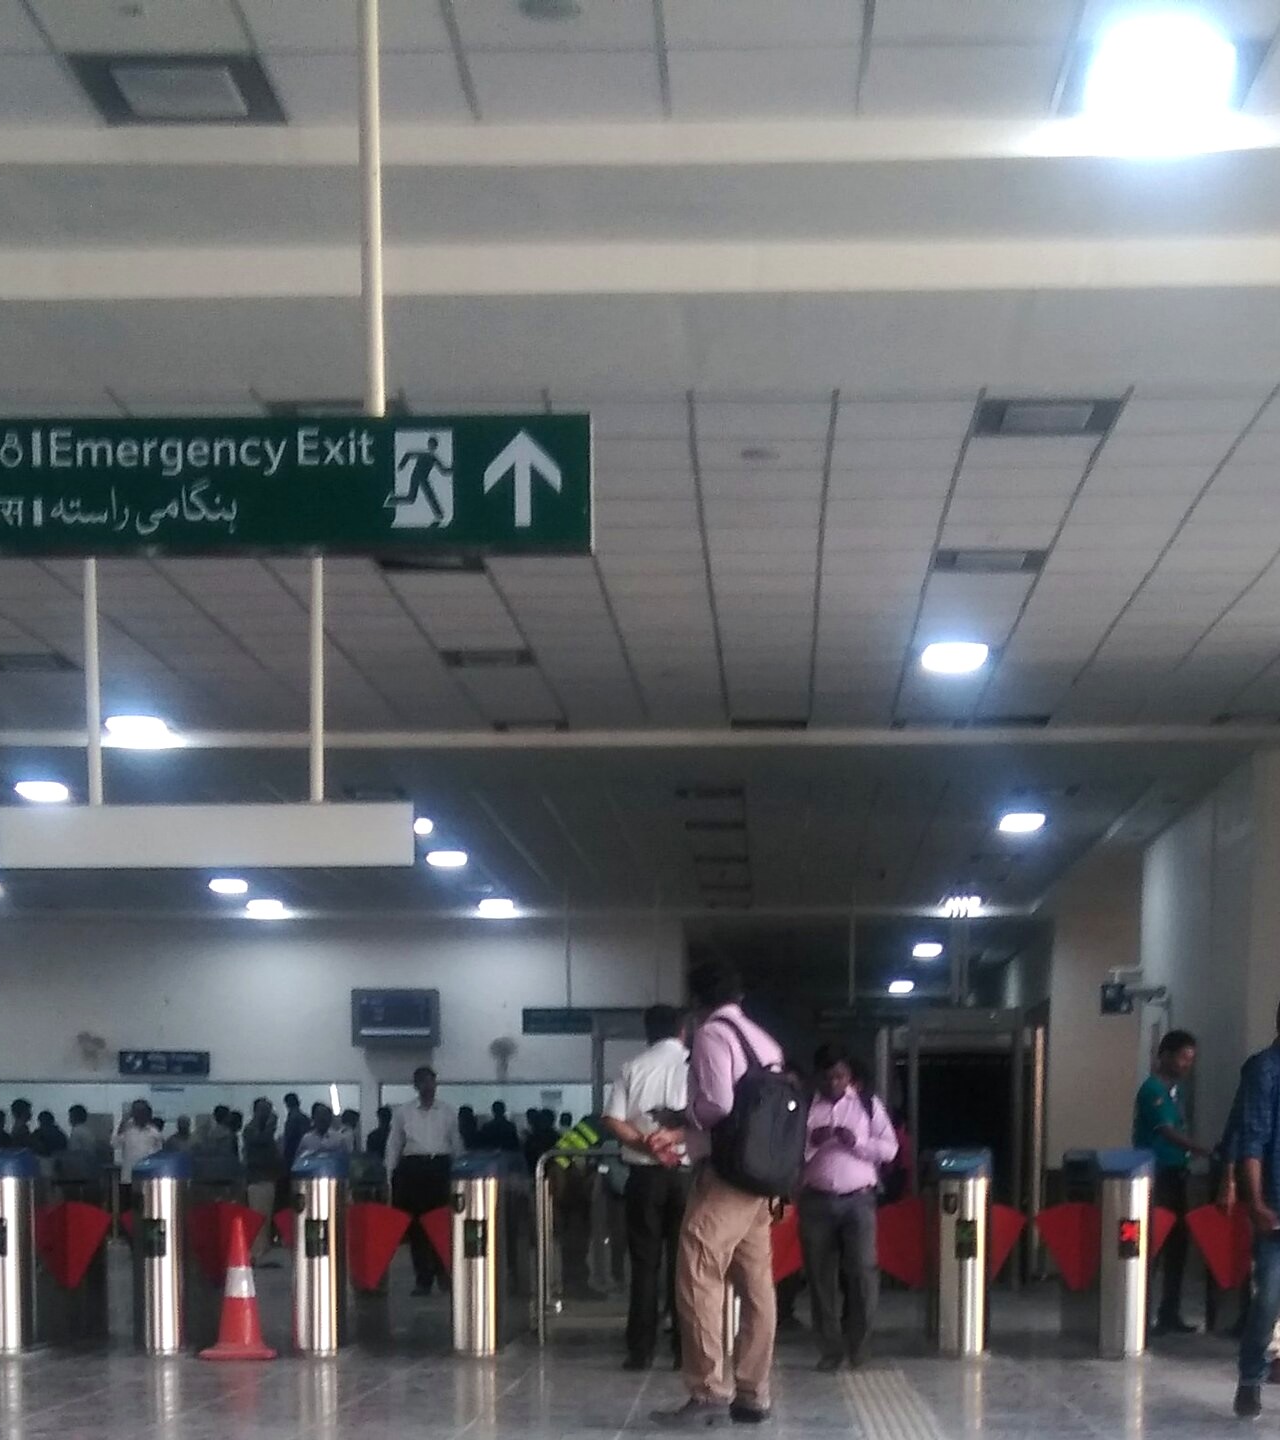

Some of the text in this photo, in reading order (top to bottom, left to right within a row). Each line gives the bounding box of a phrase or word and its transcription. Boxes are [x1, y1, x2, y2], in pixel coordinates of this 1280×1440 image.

[49, 426, 375, 477] Emergency Exit
[50, 476, 238, 535] ہنگامی راستہ
